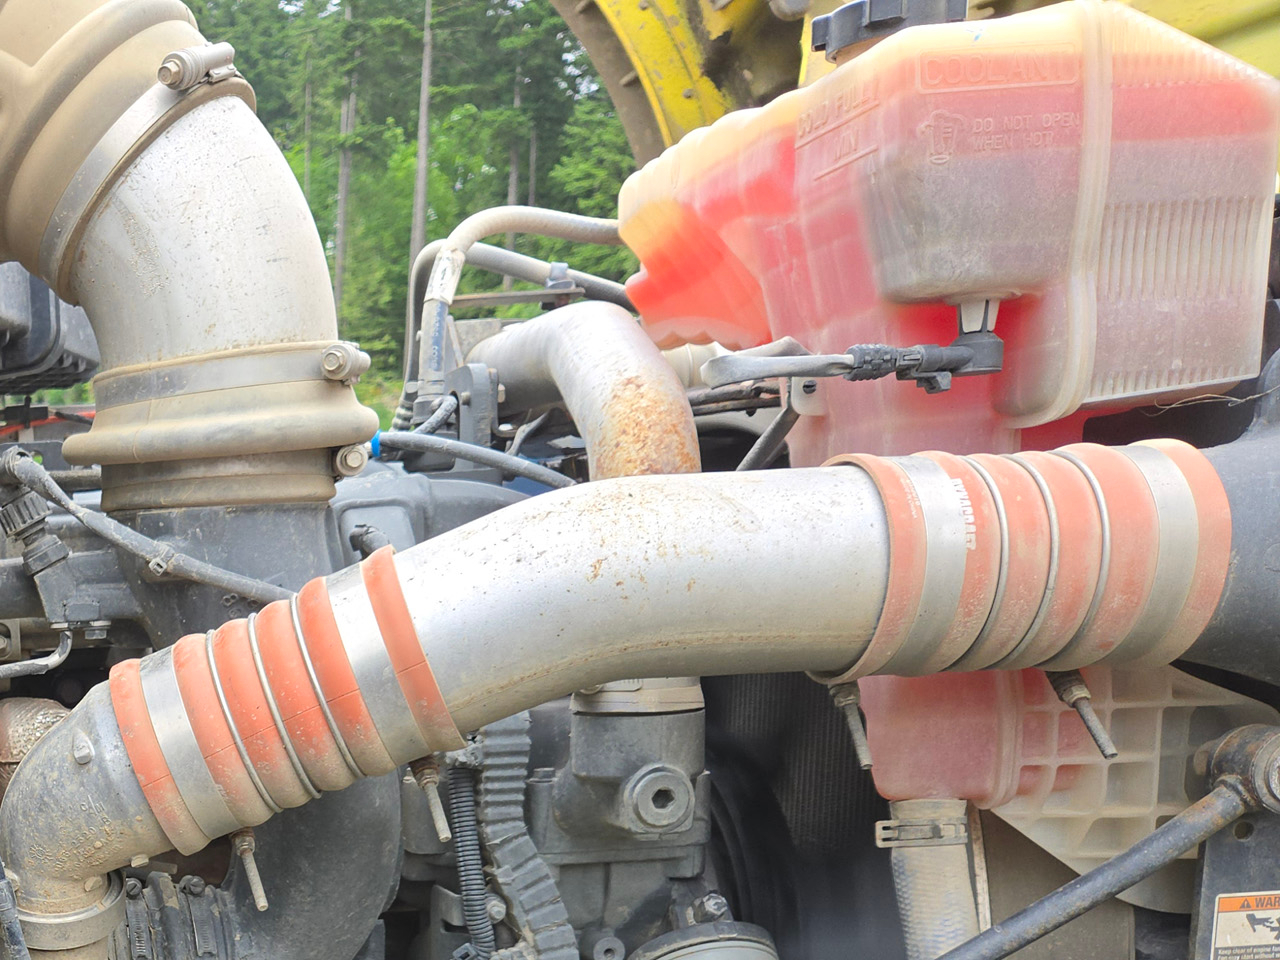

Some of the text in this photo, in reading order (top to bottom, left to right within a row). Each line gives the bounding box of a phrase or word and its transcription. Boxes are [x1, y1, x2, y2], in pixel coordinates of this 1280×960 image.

[925, 49, 1069, 85] COOLANT
[799, 100, 829, 138] COLD
[973, 111, 1081, 134] DO NOT OPEN
[834, 127, 860, 162] MIN
[972, 134, 1014, 152] WHEN
